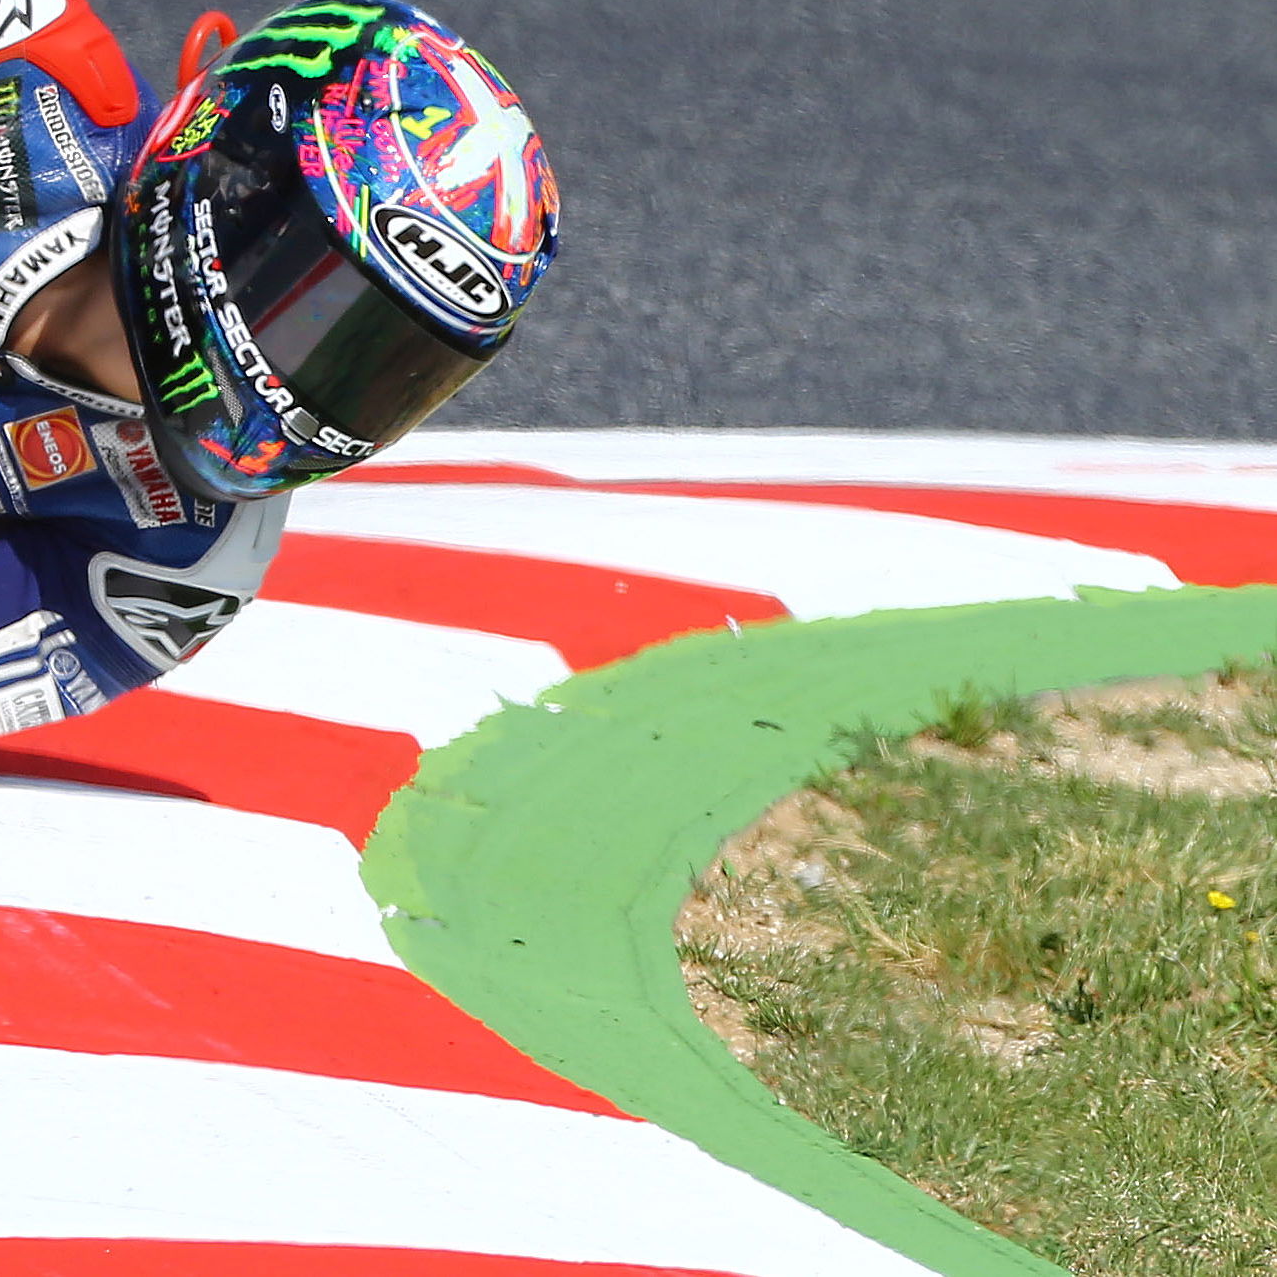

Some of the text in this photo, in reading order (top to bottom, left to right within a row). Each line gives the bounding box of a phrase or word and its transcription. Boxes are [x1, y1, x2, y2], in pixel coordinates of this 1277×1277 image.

[150, 181, 191, 357] MONSTER
[193, 198, 228, 298] SECTOR
[393, 222, 497, 310] HJC
[218, 302, 295, 414] SECTOR
[35, 421, 68, 475] ENEOS
[125, 447, 182, 526] YAMAHA
